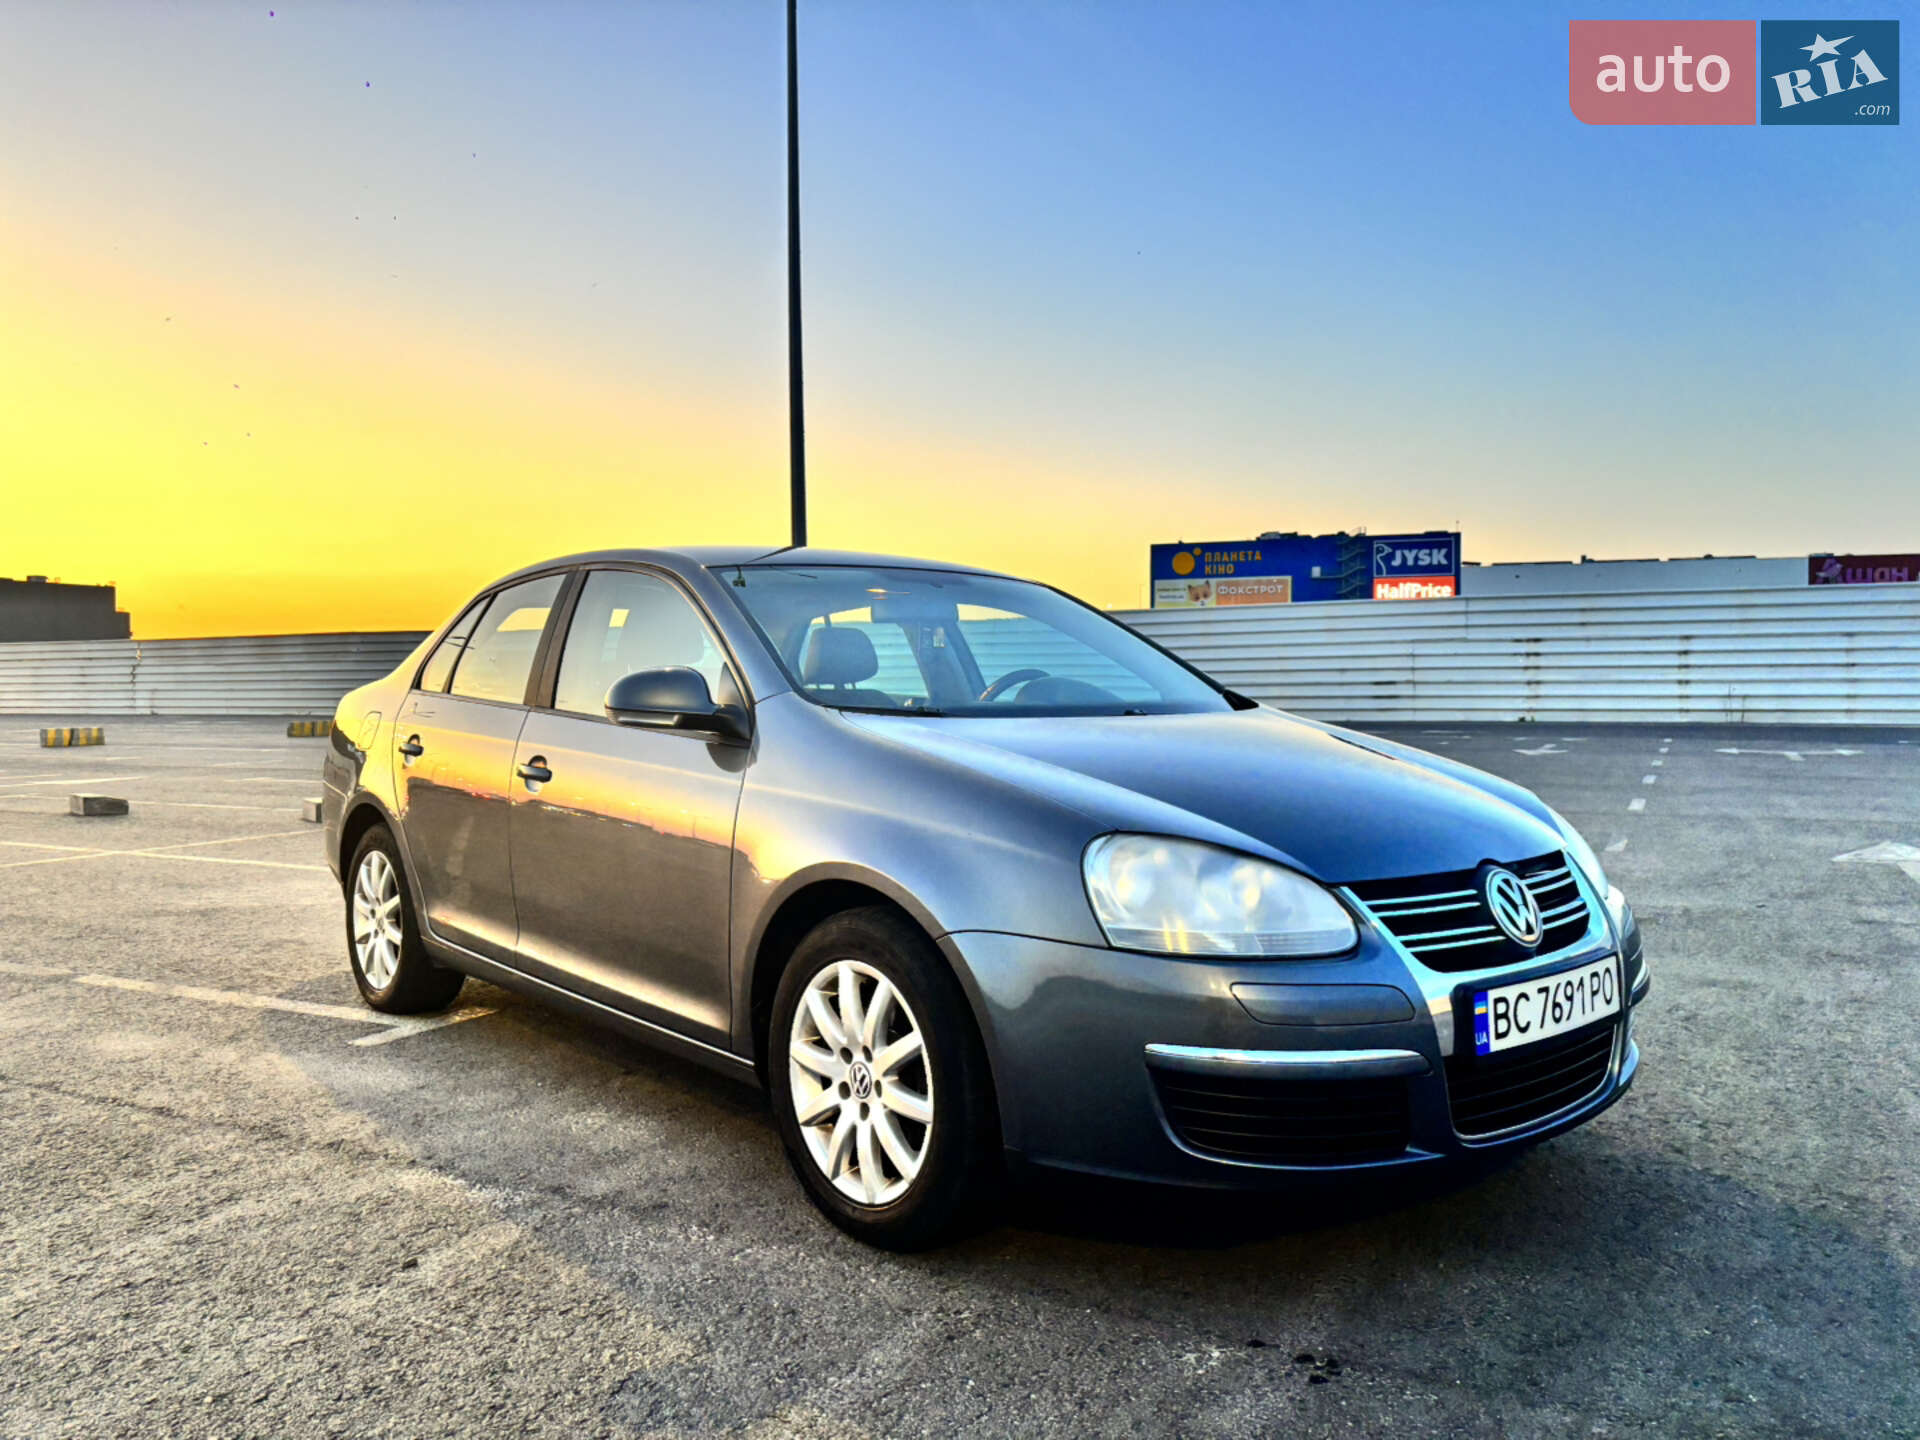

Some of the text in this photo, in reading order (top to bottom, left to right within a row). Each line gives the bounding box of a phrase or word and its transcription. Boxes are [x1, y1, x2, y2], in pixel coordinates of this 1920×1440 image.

[1204, 550, 1263, 563] ПЛАНЕТА
[1391, 548, 1449, 567] JYSK
[1204, 563, 1236, 576] КІНО
[1217, 584, 1284, 596] ФОКСТРОТ
[1375, 582, 1453, 600] HalfPrice
[1493, 966, 1614, 1041] BC 7691 PO
[1475, 1032, 1488, 1045] UA
